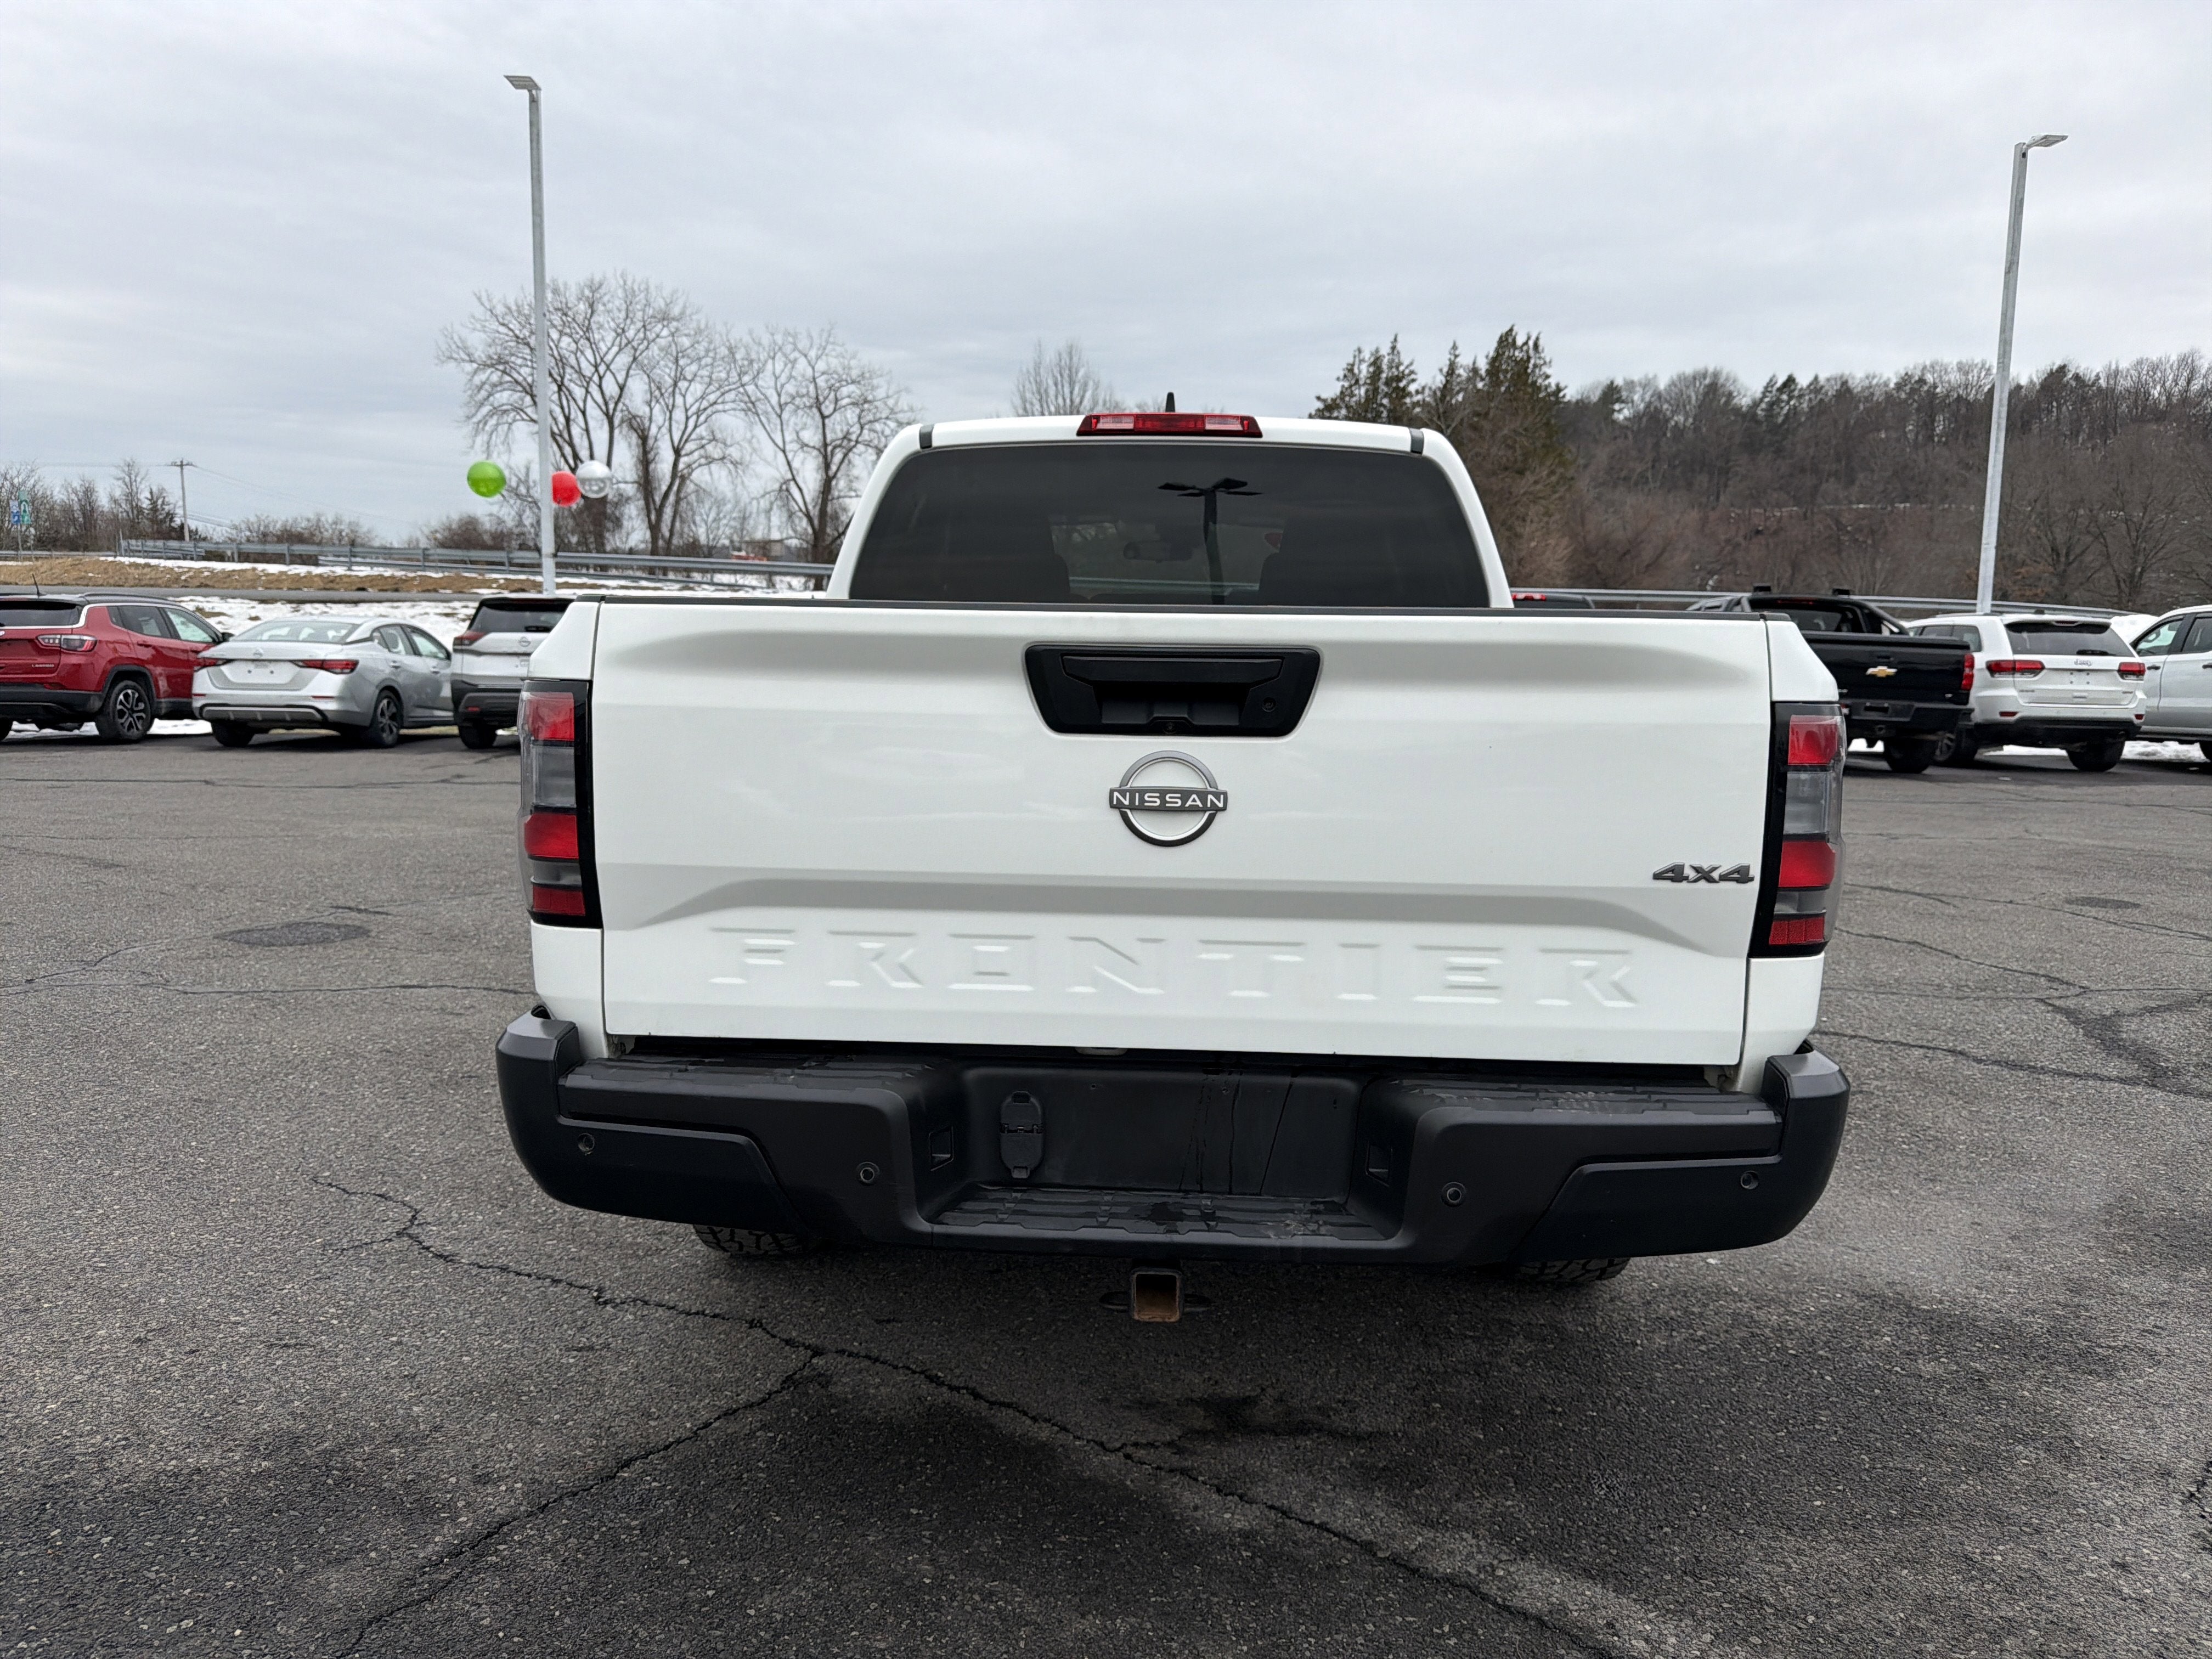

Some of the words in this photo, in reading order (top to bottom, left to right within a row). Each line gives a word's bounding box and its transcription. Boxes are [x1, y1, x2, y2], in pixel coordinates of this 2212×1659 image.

[1113, 791, 1224, 808] NISSAN
[1652, 861, 1755, 883] 4X4
[708, 927, 1638, 1007] FRONTIER
